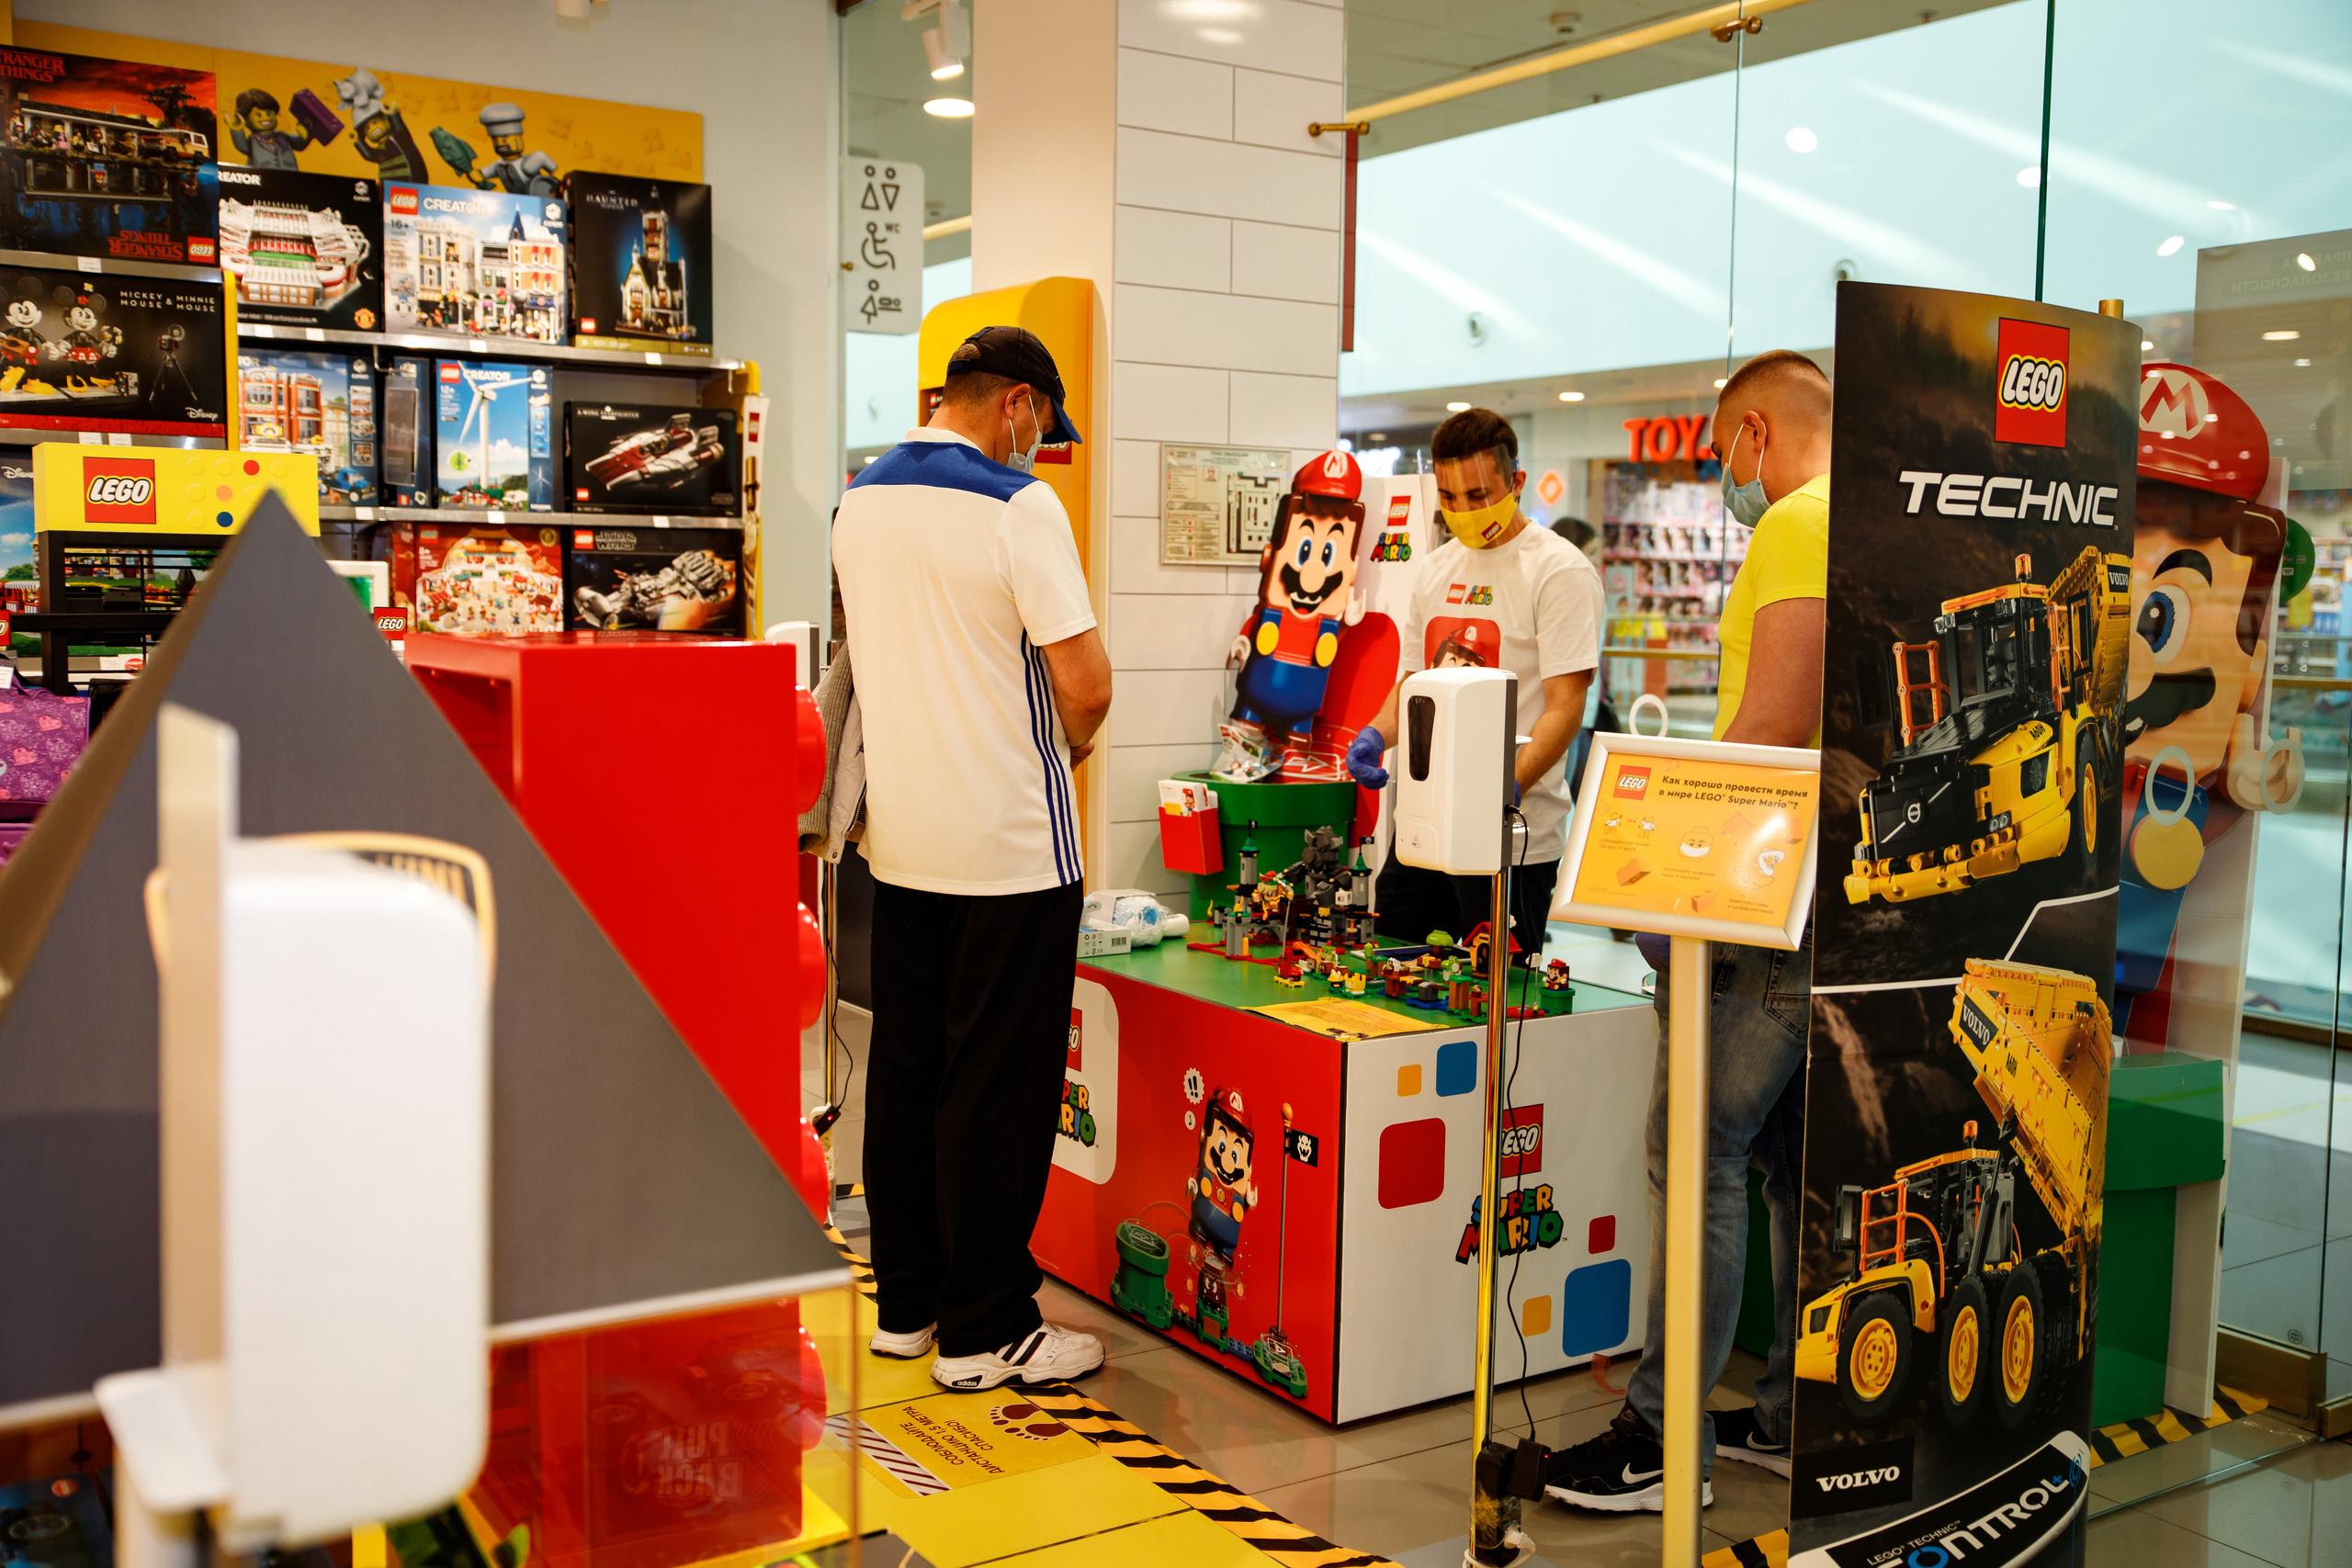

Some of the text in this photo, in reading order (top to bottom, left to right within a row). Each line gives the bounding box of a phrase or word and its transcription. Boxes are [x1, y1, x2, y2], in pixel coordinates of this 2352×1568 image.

[217, 170, 262, 186] REATOR
[392, 194, 417, 209] LEGO
[423, 197, 487, 217] CREATOR
[586, 194, 639, 208] HAUNTED
[885, 222, 901, 234] WC
[119, 230, 170, 245] THINGS
[107, 237, 184, 260] STRANGER
[189, 244, 214, 256] LEGO
[120, 290, 163, 300] MICKEY
[176, 295, 215, 304] MINNIE
[120, 299, 163, 309] MOUSE
[176, 304, 215, 313] MOUSE
[462, 369, 511, 381] CREATOR
[2000, 356, 2065, 408] LEGO
[89, 477, 151, 503] LEGO
[1899, 470, 2119, 526] TECHNIC
[1389, 504, 1408, 518] LEGO
[1378, 532, 1410, 546] SUPER
[1486, 525, 1500, 539] LEGO
[1370, 544, 1412, 562] MARIO
[2108, 571, 2130, 586] VOLVO
[1448, 589, 1464, 599] LEGO
[1471, 585, 1493, 595] SUPER
[1464, 592, 1494, 605] MARIO
[376, 615, 405, 632] LEGO
[1618, 775, 1647, 790] LEGO
[1662, 775, 1808, 798] Как хорошо провести время
[1668, 791, 1692, 800] мире
[1727, 795, 1757, 806] Super
[1962, 1003, 1991, 1045] VOLVO
[1061, 1078, 1090, 1111] PER
[1502, 1124, 1540, 1155] EGO
[902, 1405, 1005, 1474] ДИСТАНЦИЮ 1,5 МЕТРА
[944, 1419, 994, 1451] СПАСИБО!
[899, 1422, 964, 1465] СОБЛЮДАЙТЕ
[1816, 1465, 1900, 1492] VOLVO
[1876, 1474, 2070, 1568] ONTROL+
